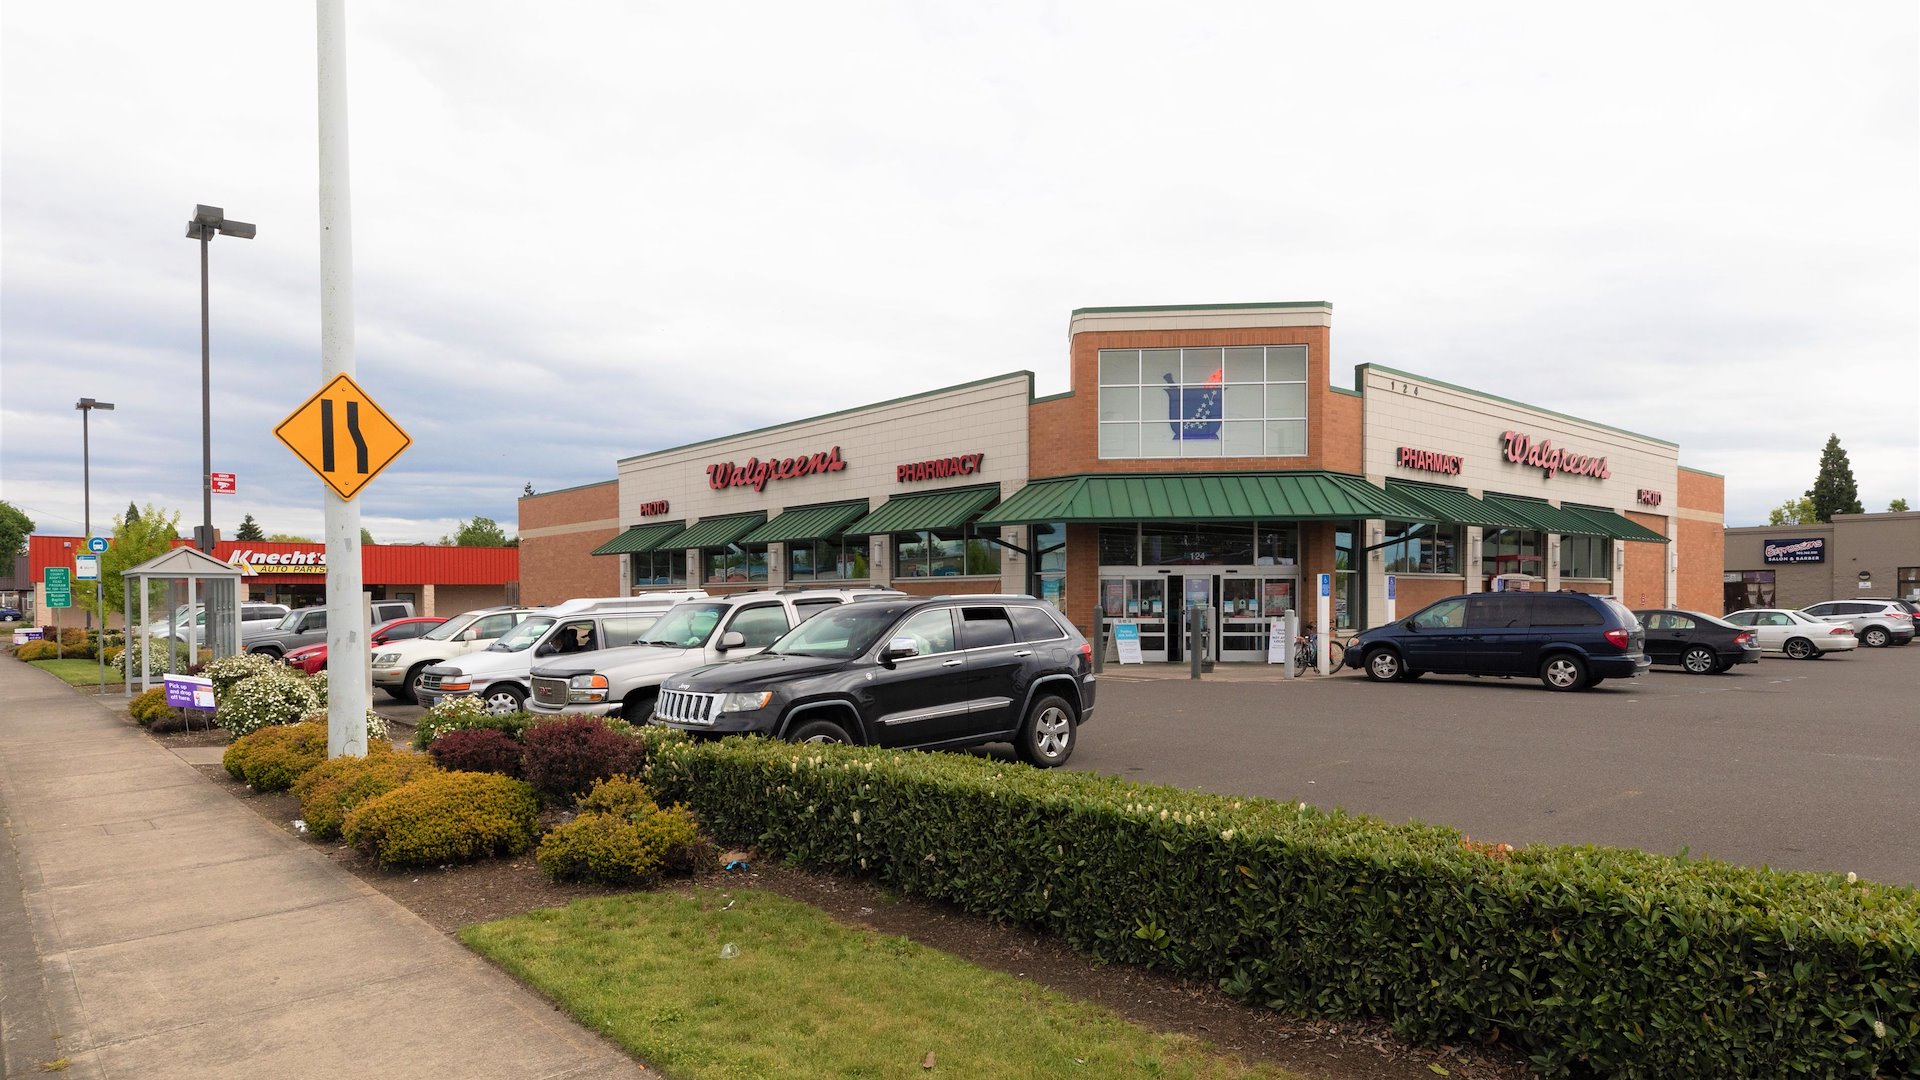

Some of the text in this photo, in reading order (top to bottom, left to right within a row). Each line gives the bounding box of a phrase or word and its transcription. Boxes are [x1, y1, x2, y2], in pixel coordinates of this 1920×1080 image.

[1398, 447, 1464, 475] PHARMACY
[1500, 431, 1611, 479] Walgreens
[706, 446, 847, 492] Walgreens
[897, 453, 984, 483] PHARMACY
[640, 500, 669, 516] PHOTO
[1638, 489, 1662, 506] PHOTO
[1190, 552, 1205, 560] 124
[1765, 540, 1823, 557] Expressions
[227, 549, 327, 576] Knecht's
[260, 565, 326, 574] AUTO PARTS
